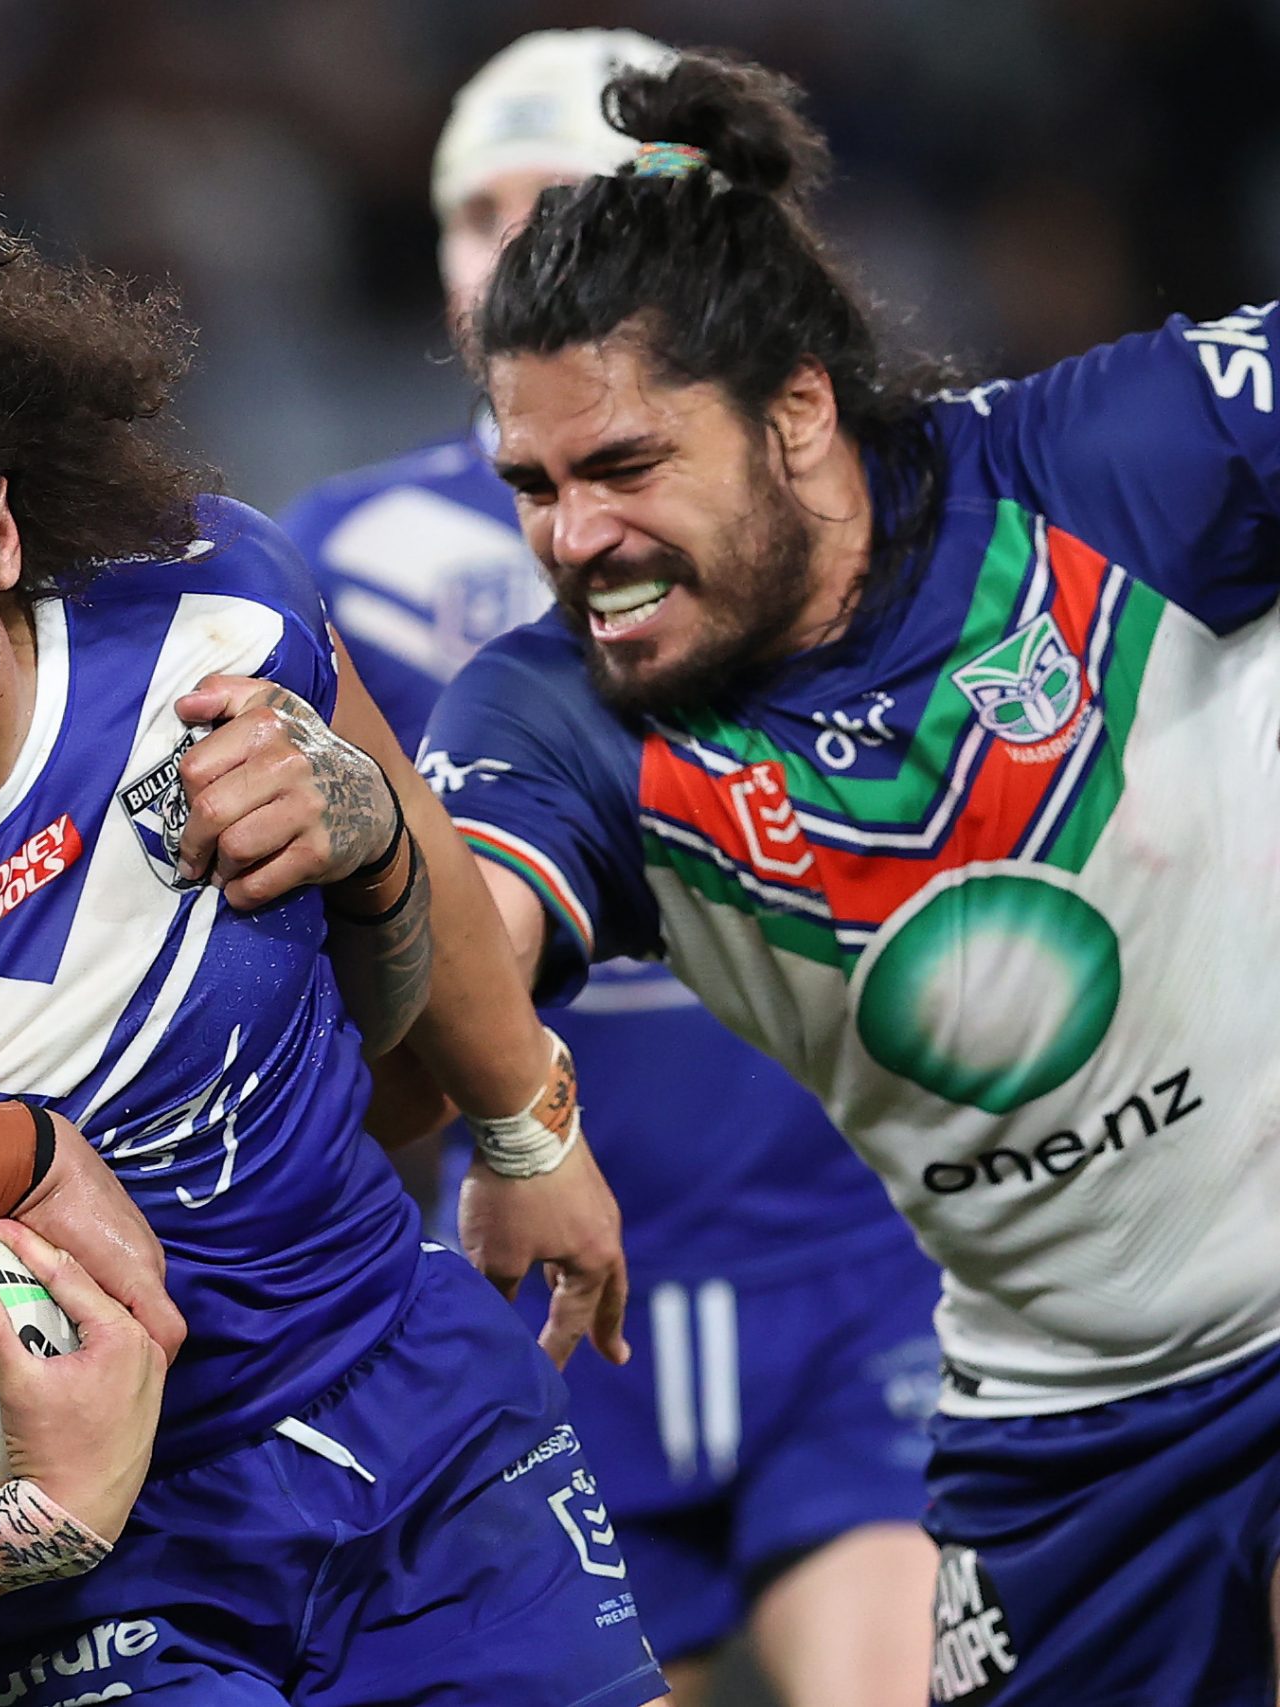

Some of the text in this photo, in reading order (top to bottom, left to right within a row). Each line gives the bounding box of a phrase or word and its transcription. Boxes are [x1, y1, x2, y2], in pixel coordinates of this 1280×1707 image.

[923, 1066, 1203, 1194] one.nz
[503, 1431, 574, 1483] CLASSIC
[28, 1495, 54, 1521] I
